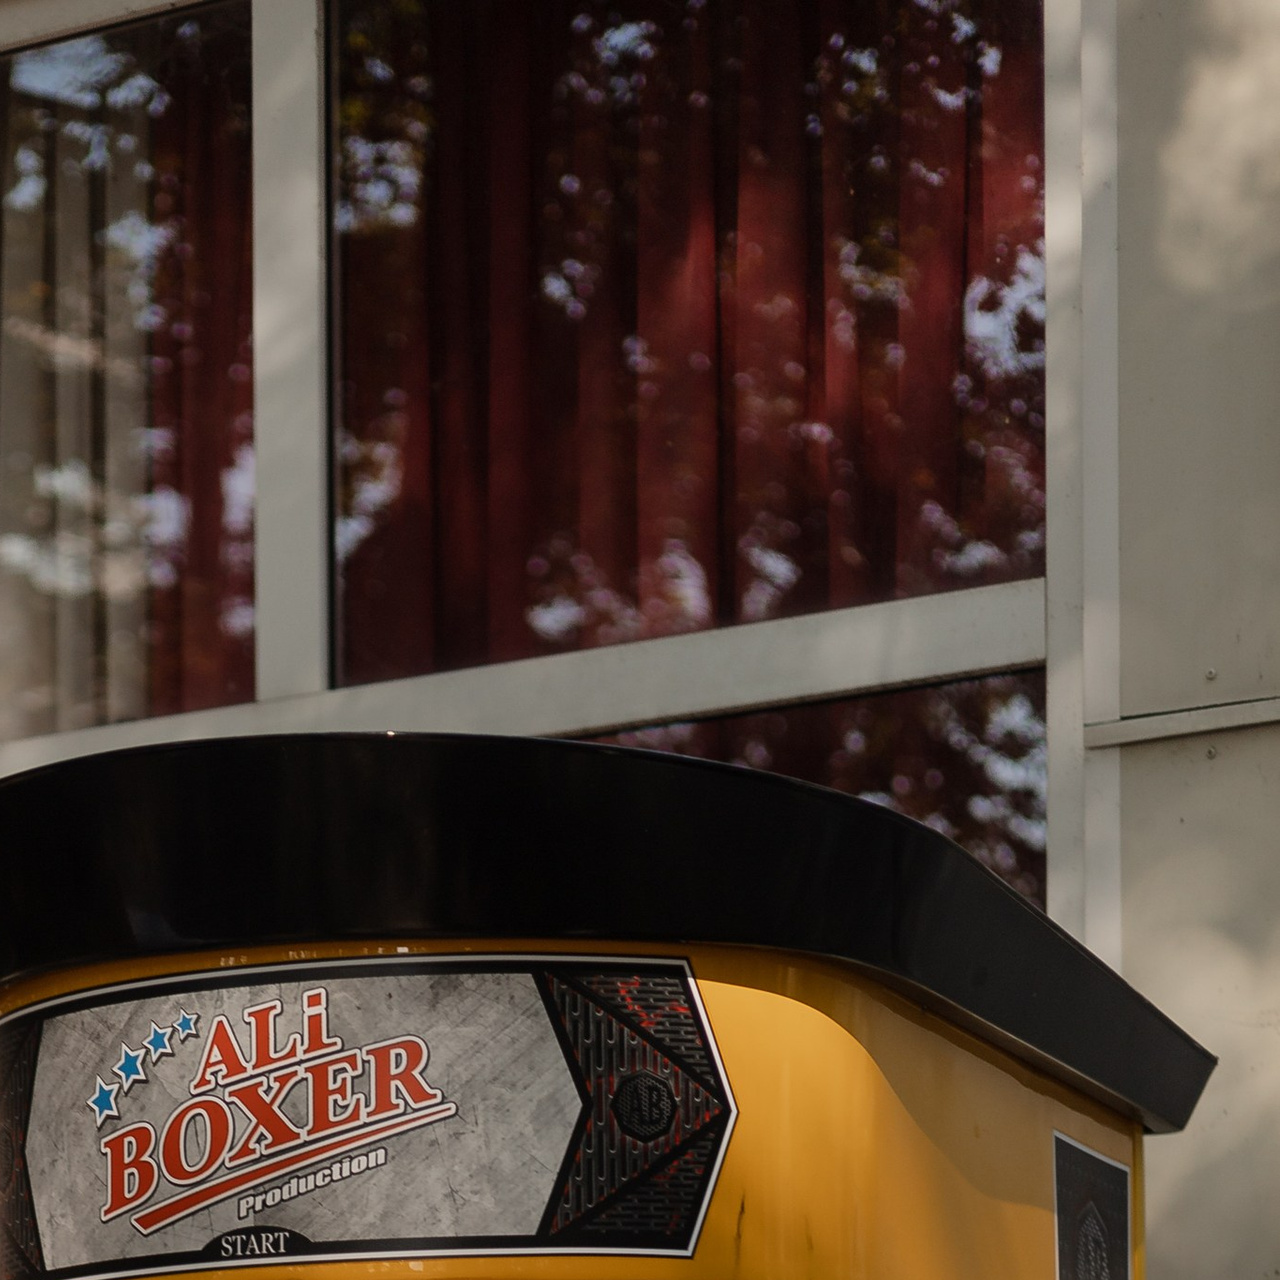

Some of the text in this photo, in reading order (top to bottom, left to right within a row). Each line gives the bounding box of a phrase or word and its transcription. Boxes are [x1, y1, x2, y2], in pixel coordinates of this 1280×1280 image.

[99, 1035, 445, 1223] BOXER
[238, 1144, 388, 1219] Production
[220, 1231, 291, 1258] START
